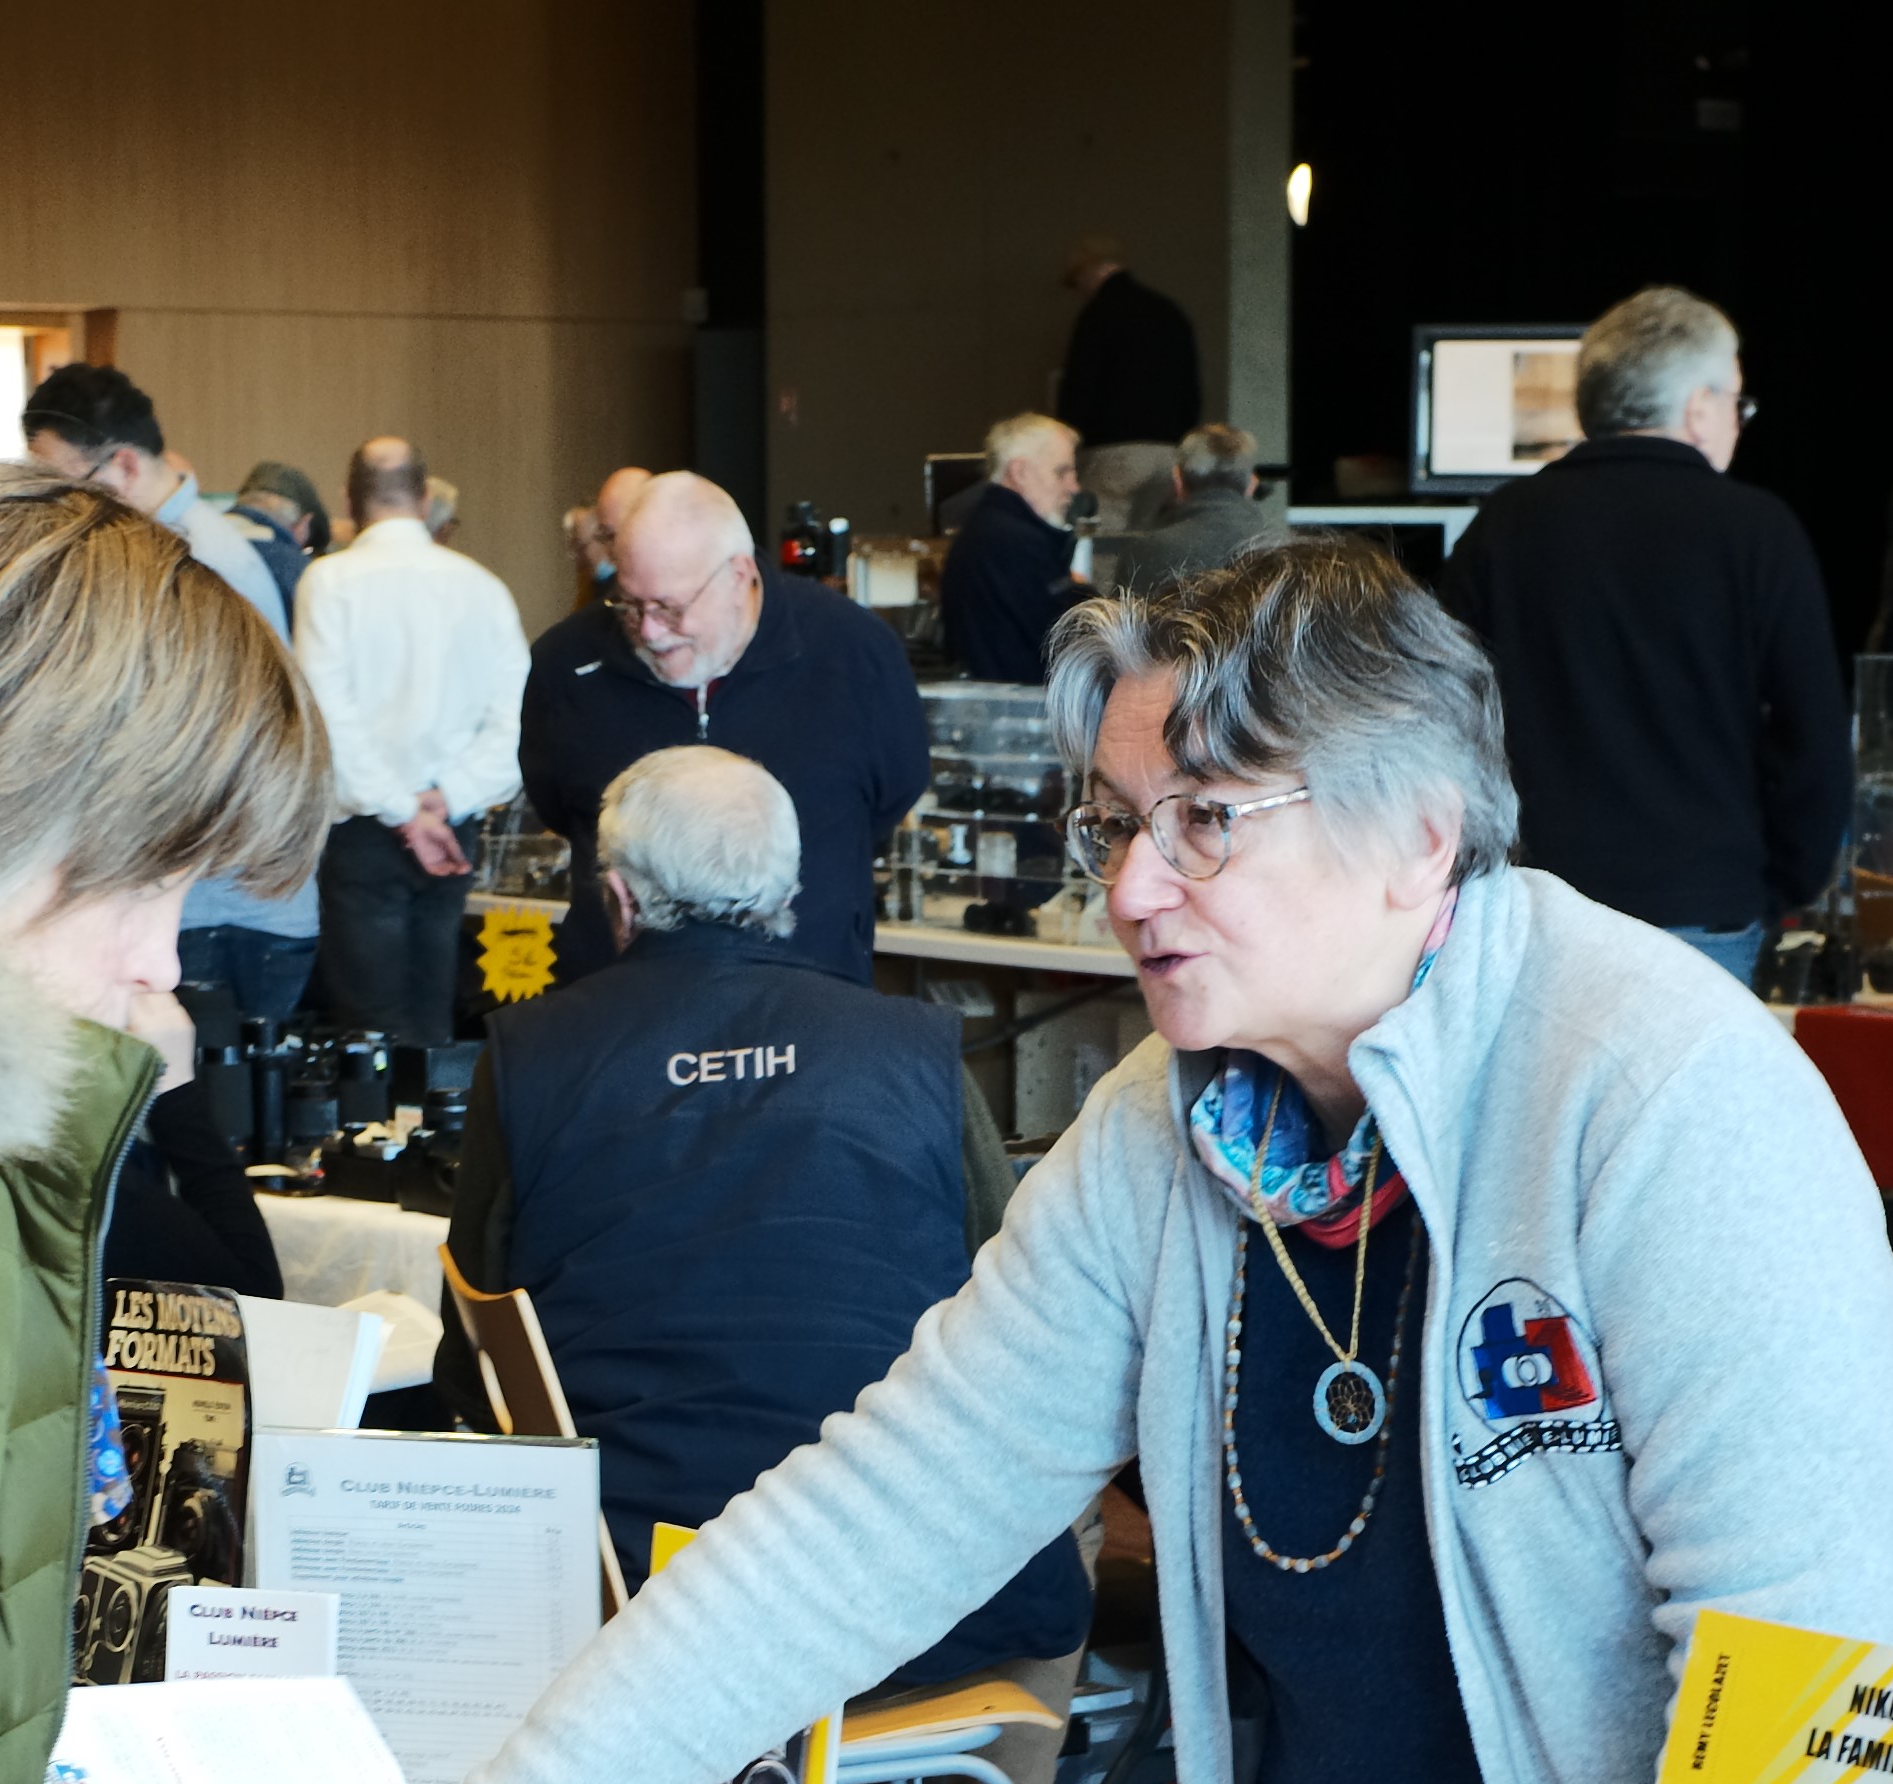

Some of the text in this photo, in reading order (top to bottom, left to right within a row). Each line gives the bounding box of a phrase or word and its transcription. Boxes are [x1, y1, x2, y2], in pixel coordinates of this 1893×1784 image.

[667, 1044, 796, 1087] CETIH
[111, 1289, 155, 1330] LES
[104, 1329, 216, 1377] FORMATS
[1805, 1727, 1833, 1760] LA
